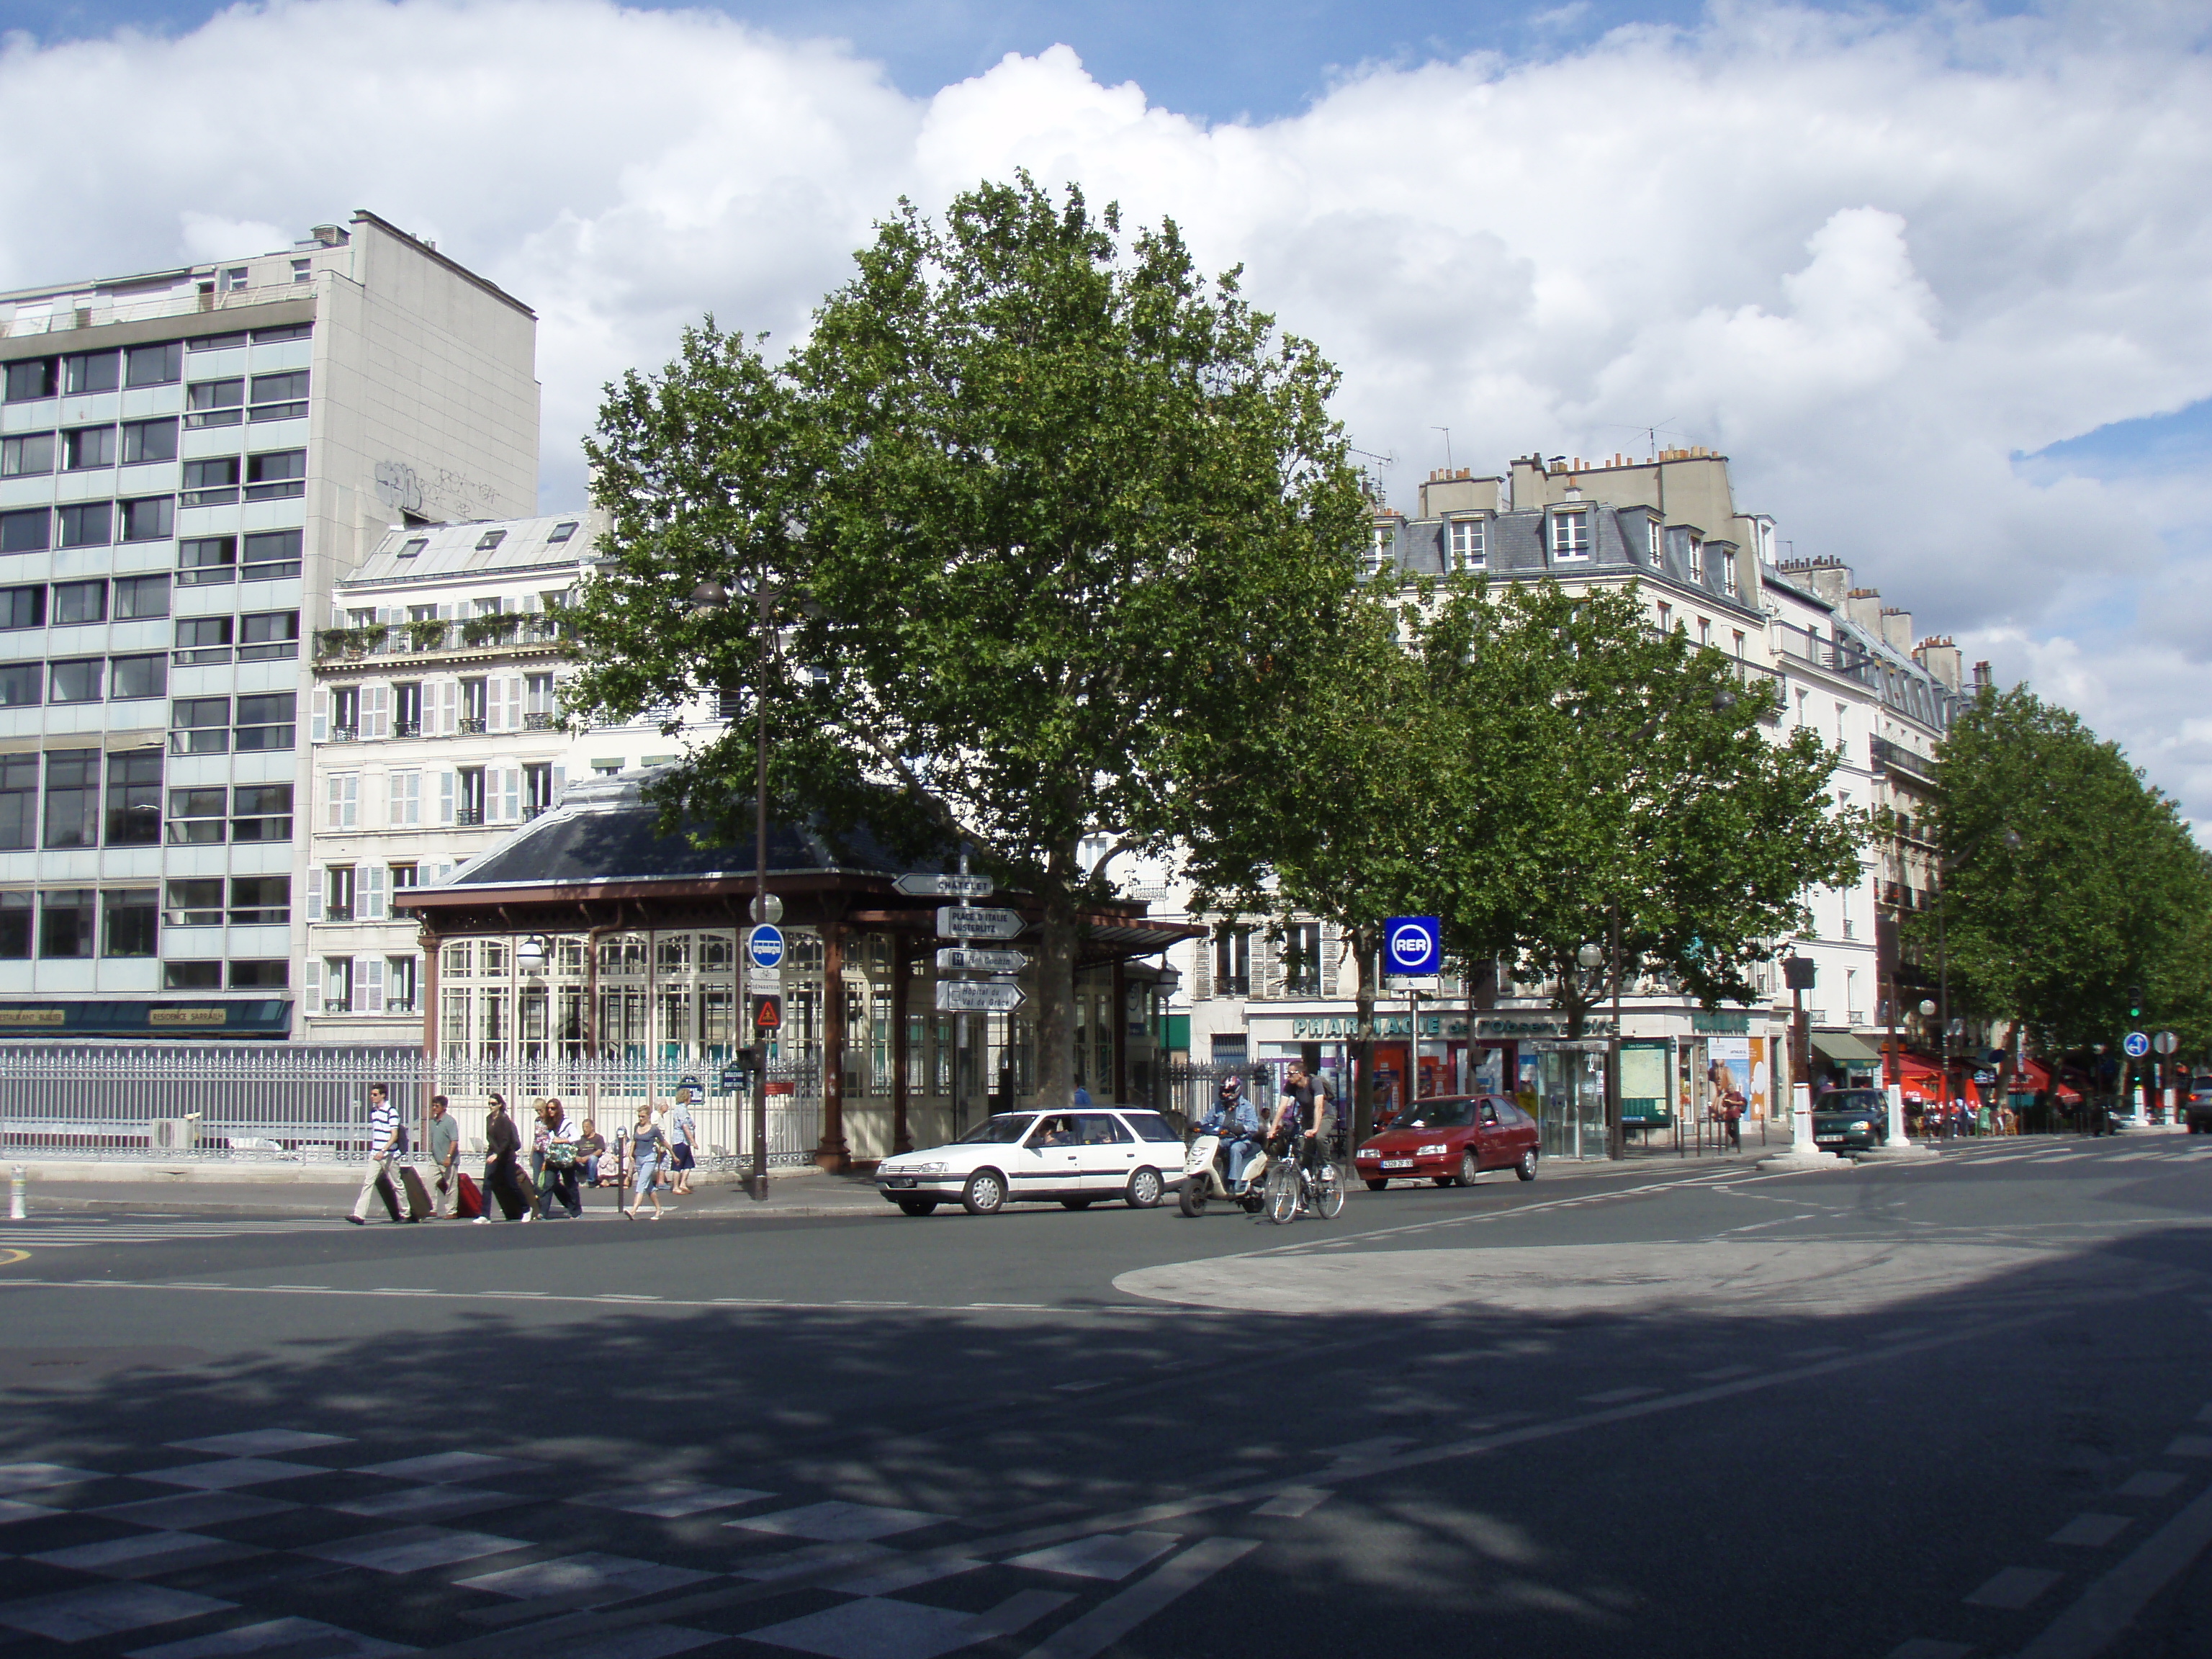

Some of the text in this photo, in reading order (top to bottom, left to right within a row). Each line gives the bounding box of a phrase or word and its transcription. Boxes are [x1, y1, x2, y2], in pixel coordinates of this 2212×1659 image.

[938, 880, 987, 891] CHÂTELET
[977, 914, 1008, 922] D'ITALIE
[952, 923, 996, 933] AUSTERLITZ
[1396, 938, 1426, 952] RER
[984, 956, 1011, 966] Cochin
[962, 987, 989, 997] Hôpital
[1478, 1019, 1615, 1035] l'Observaoire
